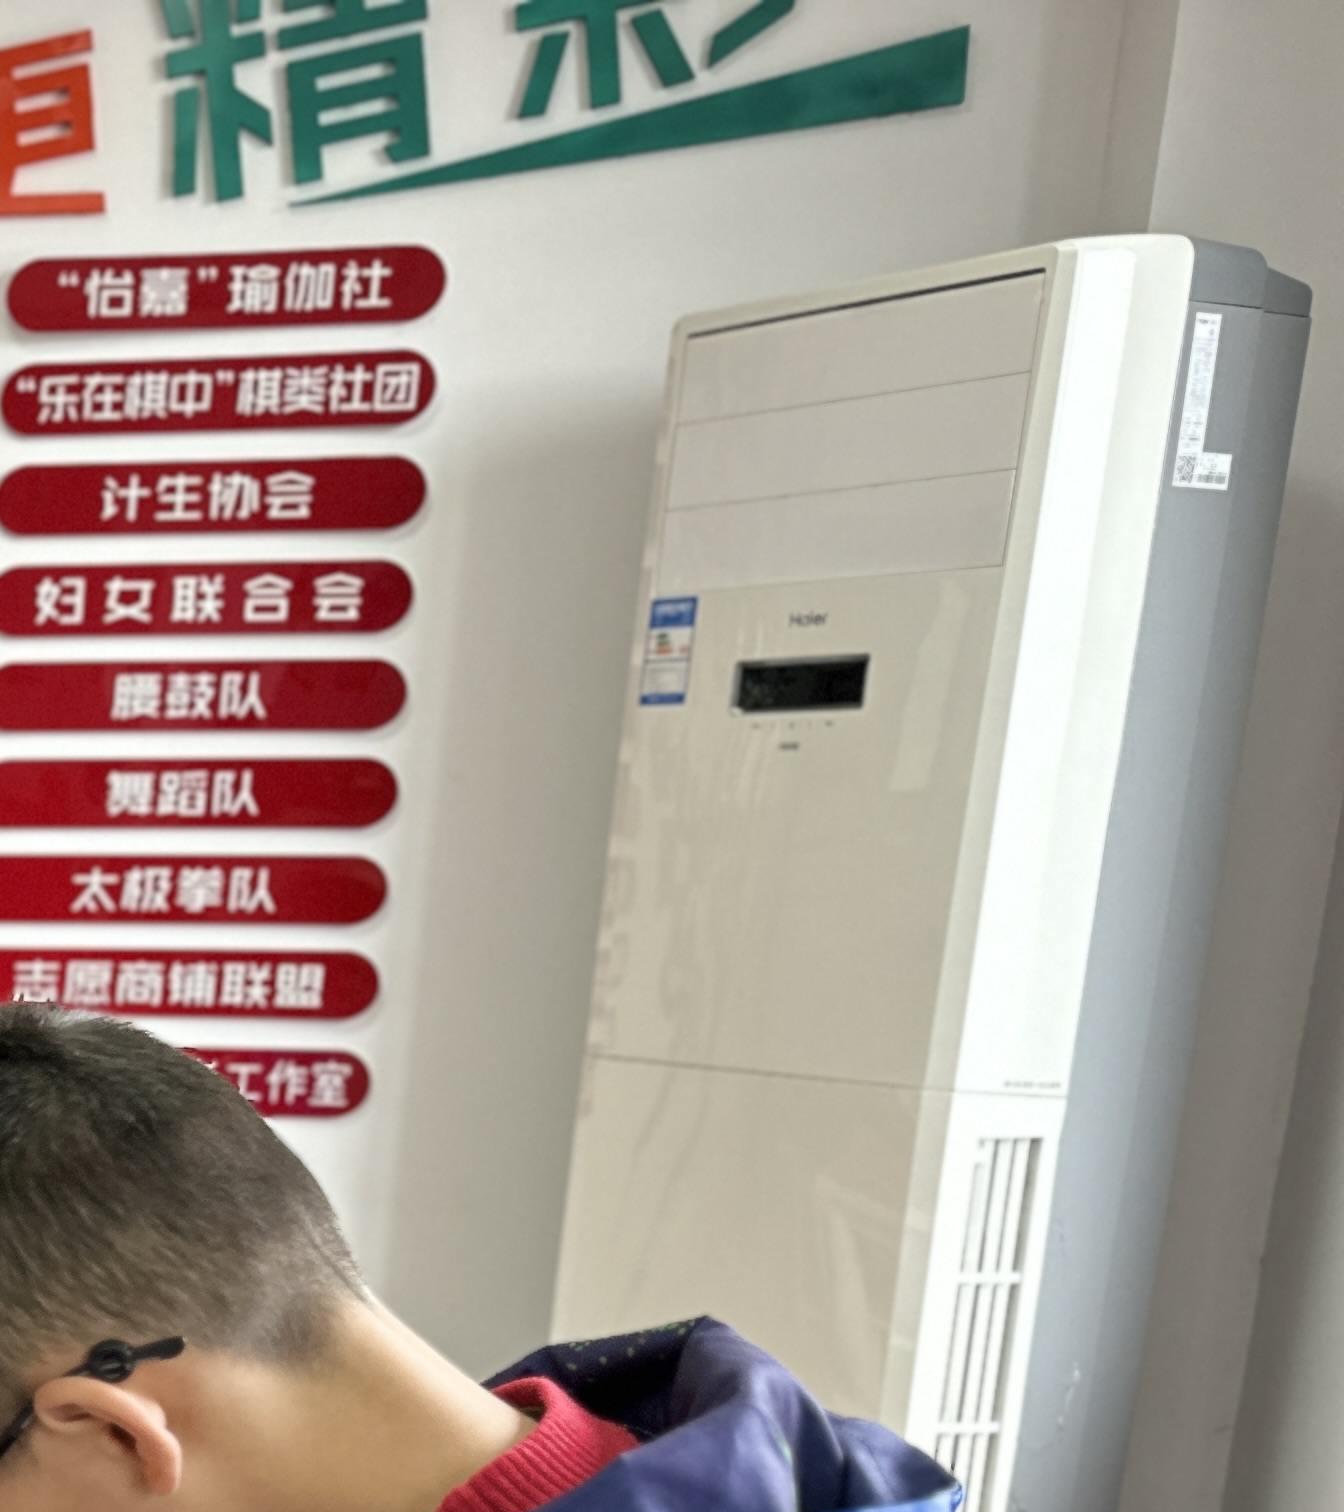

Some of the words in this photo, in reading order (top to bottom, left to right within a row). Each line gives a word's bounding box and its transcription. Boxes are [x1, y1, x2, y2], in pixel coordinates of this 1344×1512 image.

[56, 260, 393, 318] “怡嘉”瑜伽社
[14, 362, 423, 425] “乐在棋中”棋类社团
[100, 471, 315, 523] 计生协会
[34, 573, 365, 625] 妇女联合会
[110, 672, 267, 721] 腰鼓队
[106, 770, 260, 818] 舞蹈队
[70, 866, 276, 914] 太极拳队
[12, 959, 326, 1010] 志愿商铺联盟
[209, 1060, 354, 1108] 工作室
